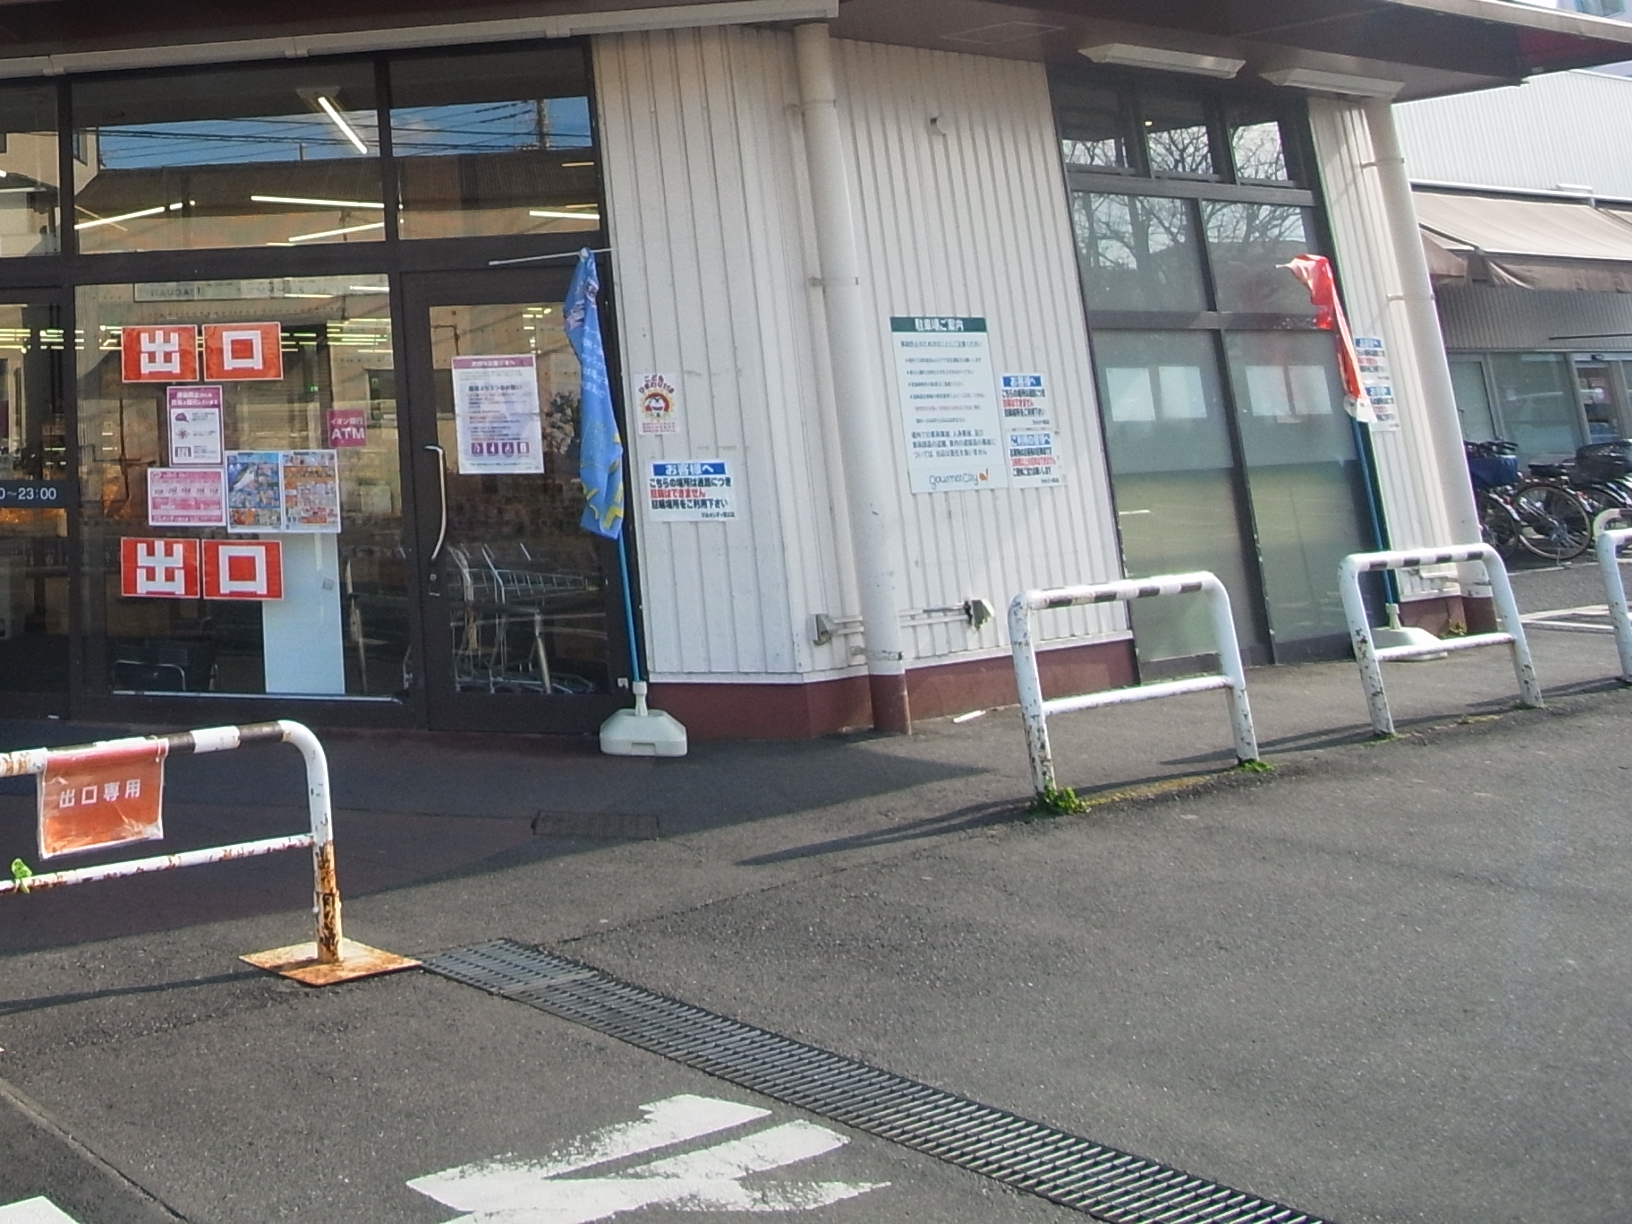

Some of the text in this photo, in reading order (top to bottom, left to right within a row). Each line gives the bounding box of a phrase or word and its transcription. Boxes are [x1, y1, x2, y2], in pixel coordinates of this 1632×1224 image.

[140, 330, 263, 374] 出口
[331, 427, 365, 440] ATM
[665, 463, 714, 475] お客様へ
[136, 540, 268, 595] 出口
[59, 779, 141, 808] 出口専用
